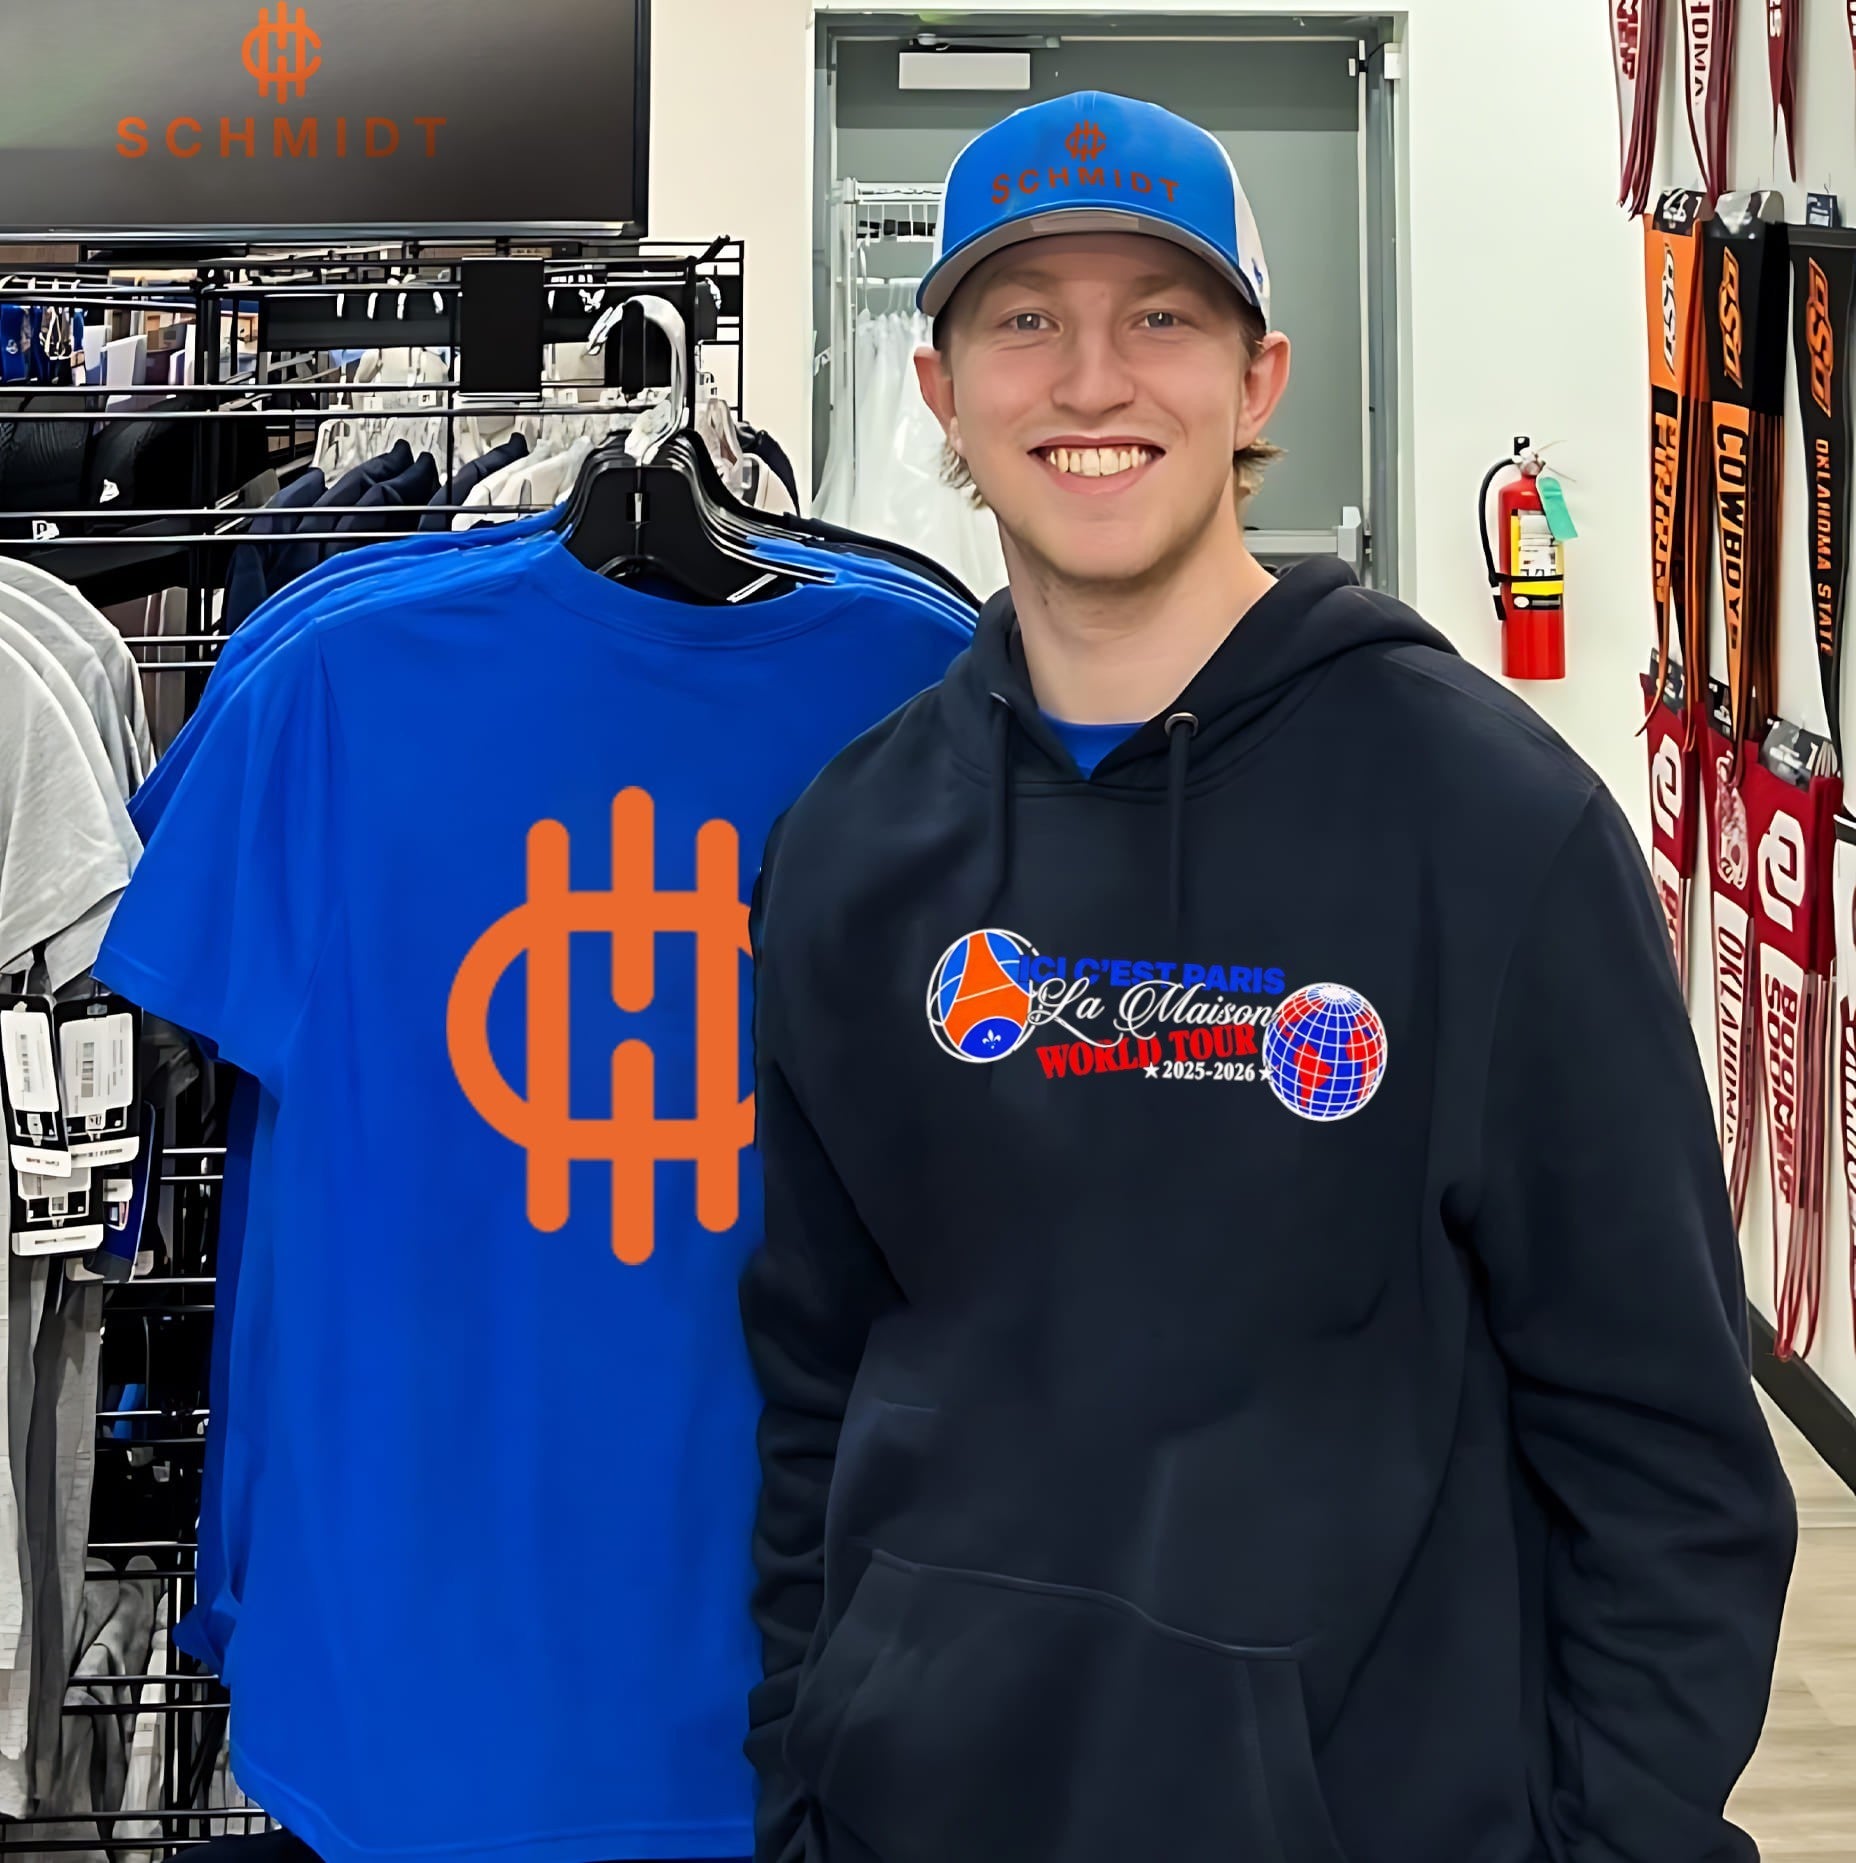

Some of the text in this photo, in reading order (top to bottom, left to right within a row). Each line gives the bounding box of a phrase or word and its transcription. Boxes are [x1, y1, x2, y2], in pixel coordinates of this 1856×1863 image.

[115, 116, 447, 159] SCHMIDT
[991, 166, 1179, 204] SCHMIDT
[1717, 424, 1749, 650] COWBOY
[1018, 955, 1286, 995] ICI C'EST PARIS
[1028, 976, 1274, 1048] La Maison
[1036, 1023, 1258, 1079] WORLD TOUR
[1162, 1060, 1256, 1082] 2025-2026
